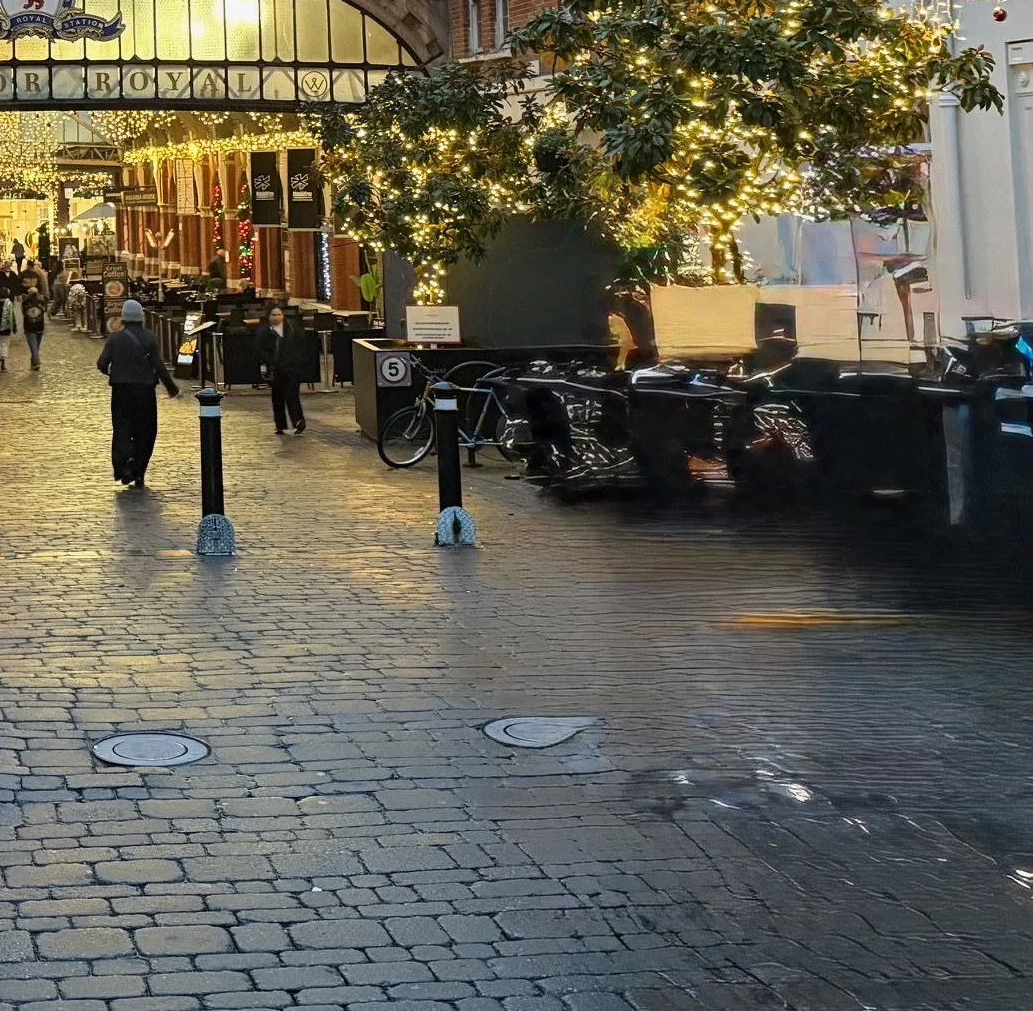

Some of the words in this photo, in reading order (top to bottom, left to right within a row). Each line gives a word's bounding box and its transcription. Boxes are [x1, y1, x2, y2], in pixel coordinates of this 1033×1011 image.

[16, 15, 47, 25] ROYAL
[63, 19, 104, 30] STATION
[95, 71, 253, 94] ROYAL
[388, 362, 399, 377] 5
